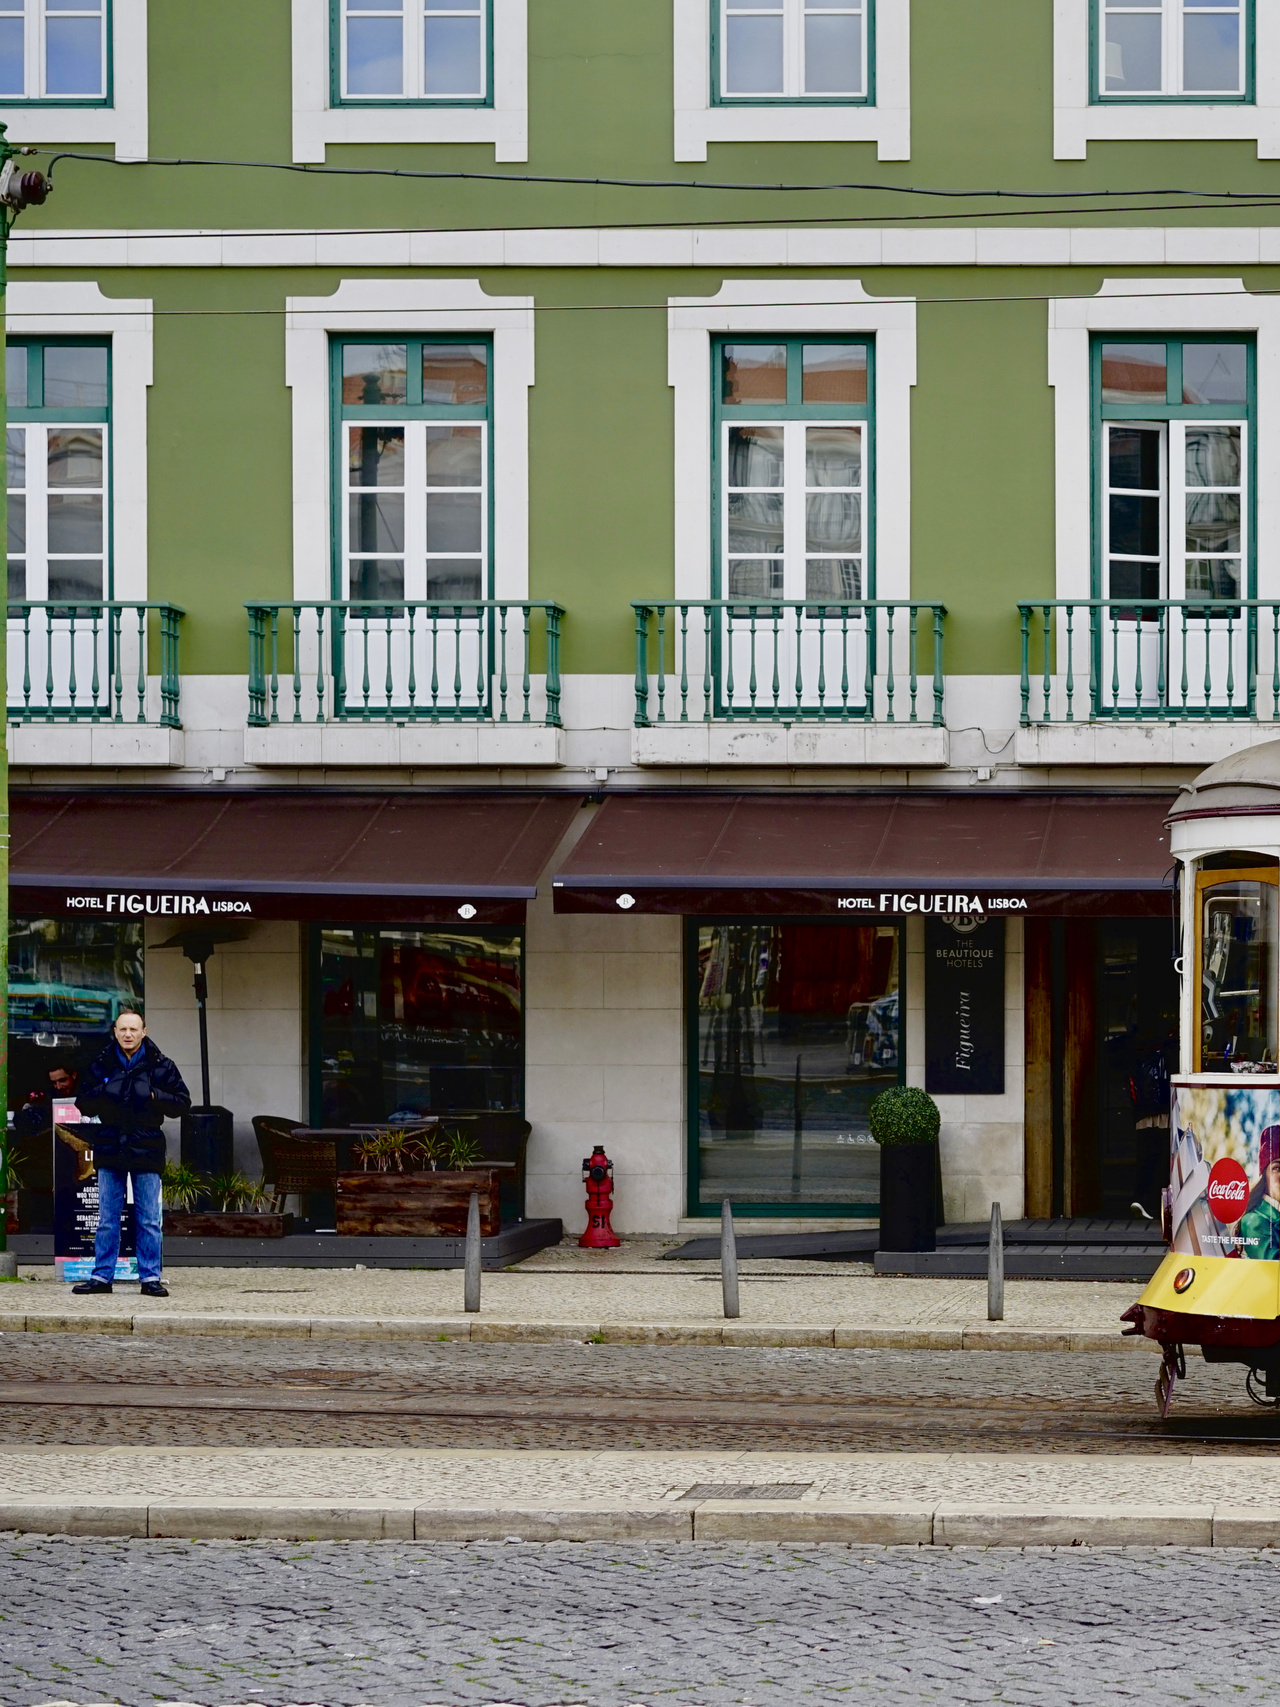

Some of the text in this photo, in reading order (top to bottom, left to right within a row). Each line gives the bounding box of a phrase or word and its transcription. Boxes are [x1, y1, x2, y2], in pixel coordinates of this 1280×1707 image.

[66, 894, 251, 914] HOTEL FIGUEIRA LISBOA
[838, 894, 1027, 913] HOTEL FIGUEIRA LISBOA
[957, 940, 974, 948] THE
[936, 949, 994, 958] BEAUTIQUE
[946, 960, 983, 968] HOTELS
[955, 991, 975, 1070] Figueira
[1209, 1180, 1248, 1200] Coca-Cola
[1201, 1235, 1259, 1246] TASTE THE FEELING
